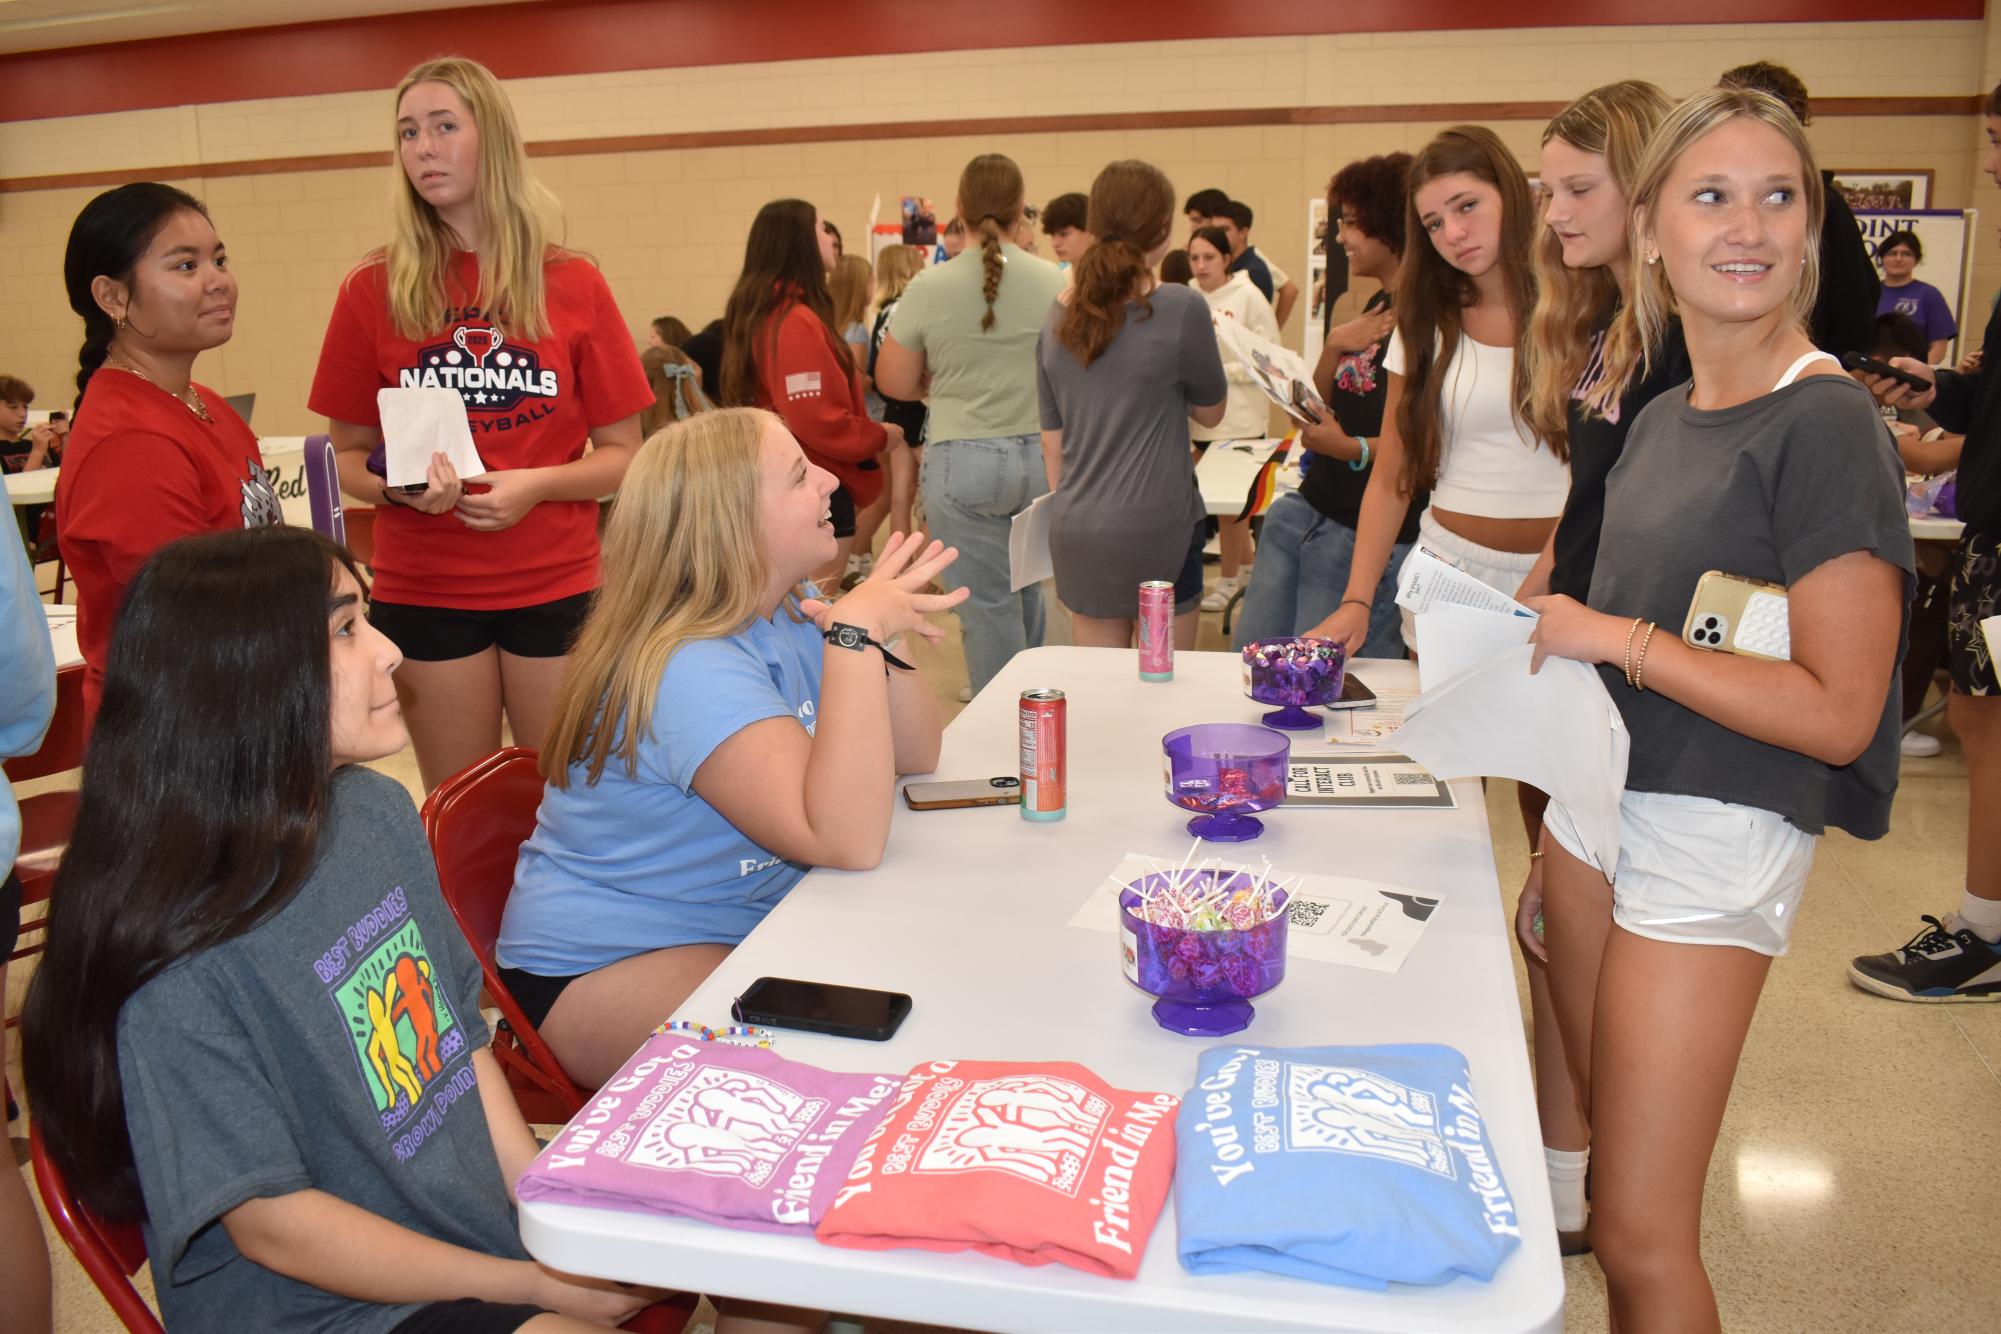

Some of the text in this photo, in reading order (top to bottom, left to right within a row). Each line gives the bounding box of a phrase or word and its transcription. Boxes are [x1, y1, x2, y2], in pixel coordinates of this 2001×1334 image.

[400, 366, 558, 397] NATIONALS
[470, 402, 557, 433] EYBALL
[1292, 767, 1311, 793] CALL FOR
[1313, 766, 1335, 794] INTERACT
[1337, 773, 1356, 787] CLUB
[313, 886, 408, 984] BEST BUDDIES
[434, 1060, 476, 1115] POIN
[547, 1044, 701, 1170] You've Got a
[595, 1061, 696, 1158] BEST BUDDIES
[835, 1076, 901, 1118] Me!
[1251, 1058, 1281, 1153] BEST BUDDIES
[881, 1077, 964, 1175] BEST BUDDIES
[1107, 1122, 1152, 1148] in
[1194, 1090, 1256, 1187] You've
[1443, 1115, 1481, 1142] in
[1088, 1137, 1140, 1255] Friend
[1445, 1138, 1521, 1239] Friend
